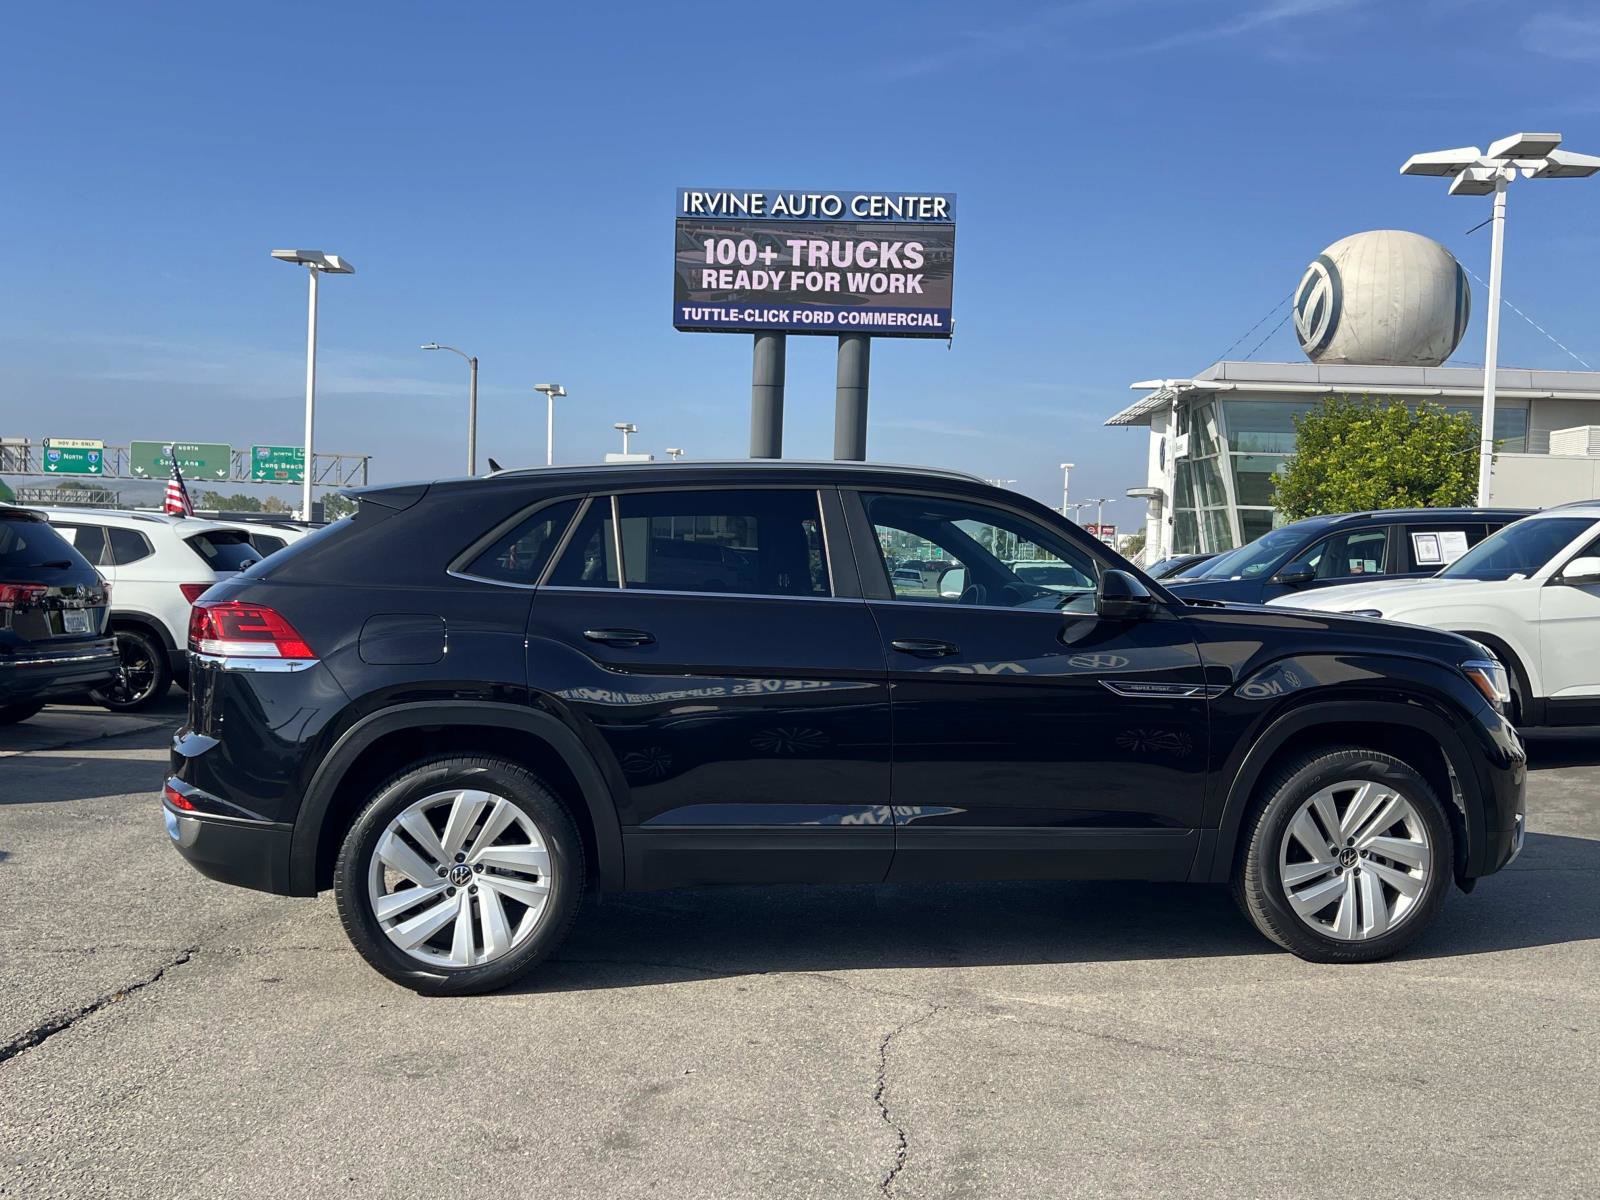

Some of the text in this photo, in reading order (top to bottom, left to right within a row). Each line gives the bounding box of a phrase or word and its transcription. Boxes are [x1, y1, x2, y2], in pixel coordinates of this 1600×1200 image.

[683, 191, 948, 218] IRVINE AUTO CENTER
[703, 238, 924, 270] 100+ TRUCKS
[702, 269, 924, 294] READY FOR WORK
[682, 307, 942, 327] TUTTLE-CLICK FORD COMMERCIAL
[260, 462, 279, 470] Long
